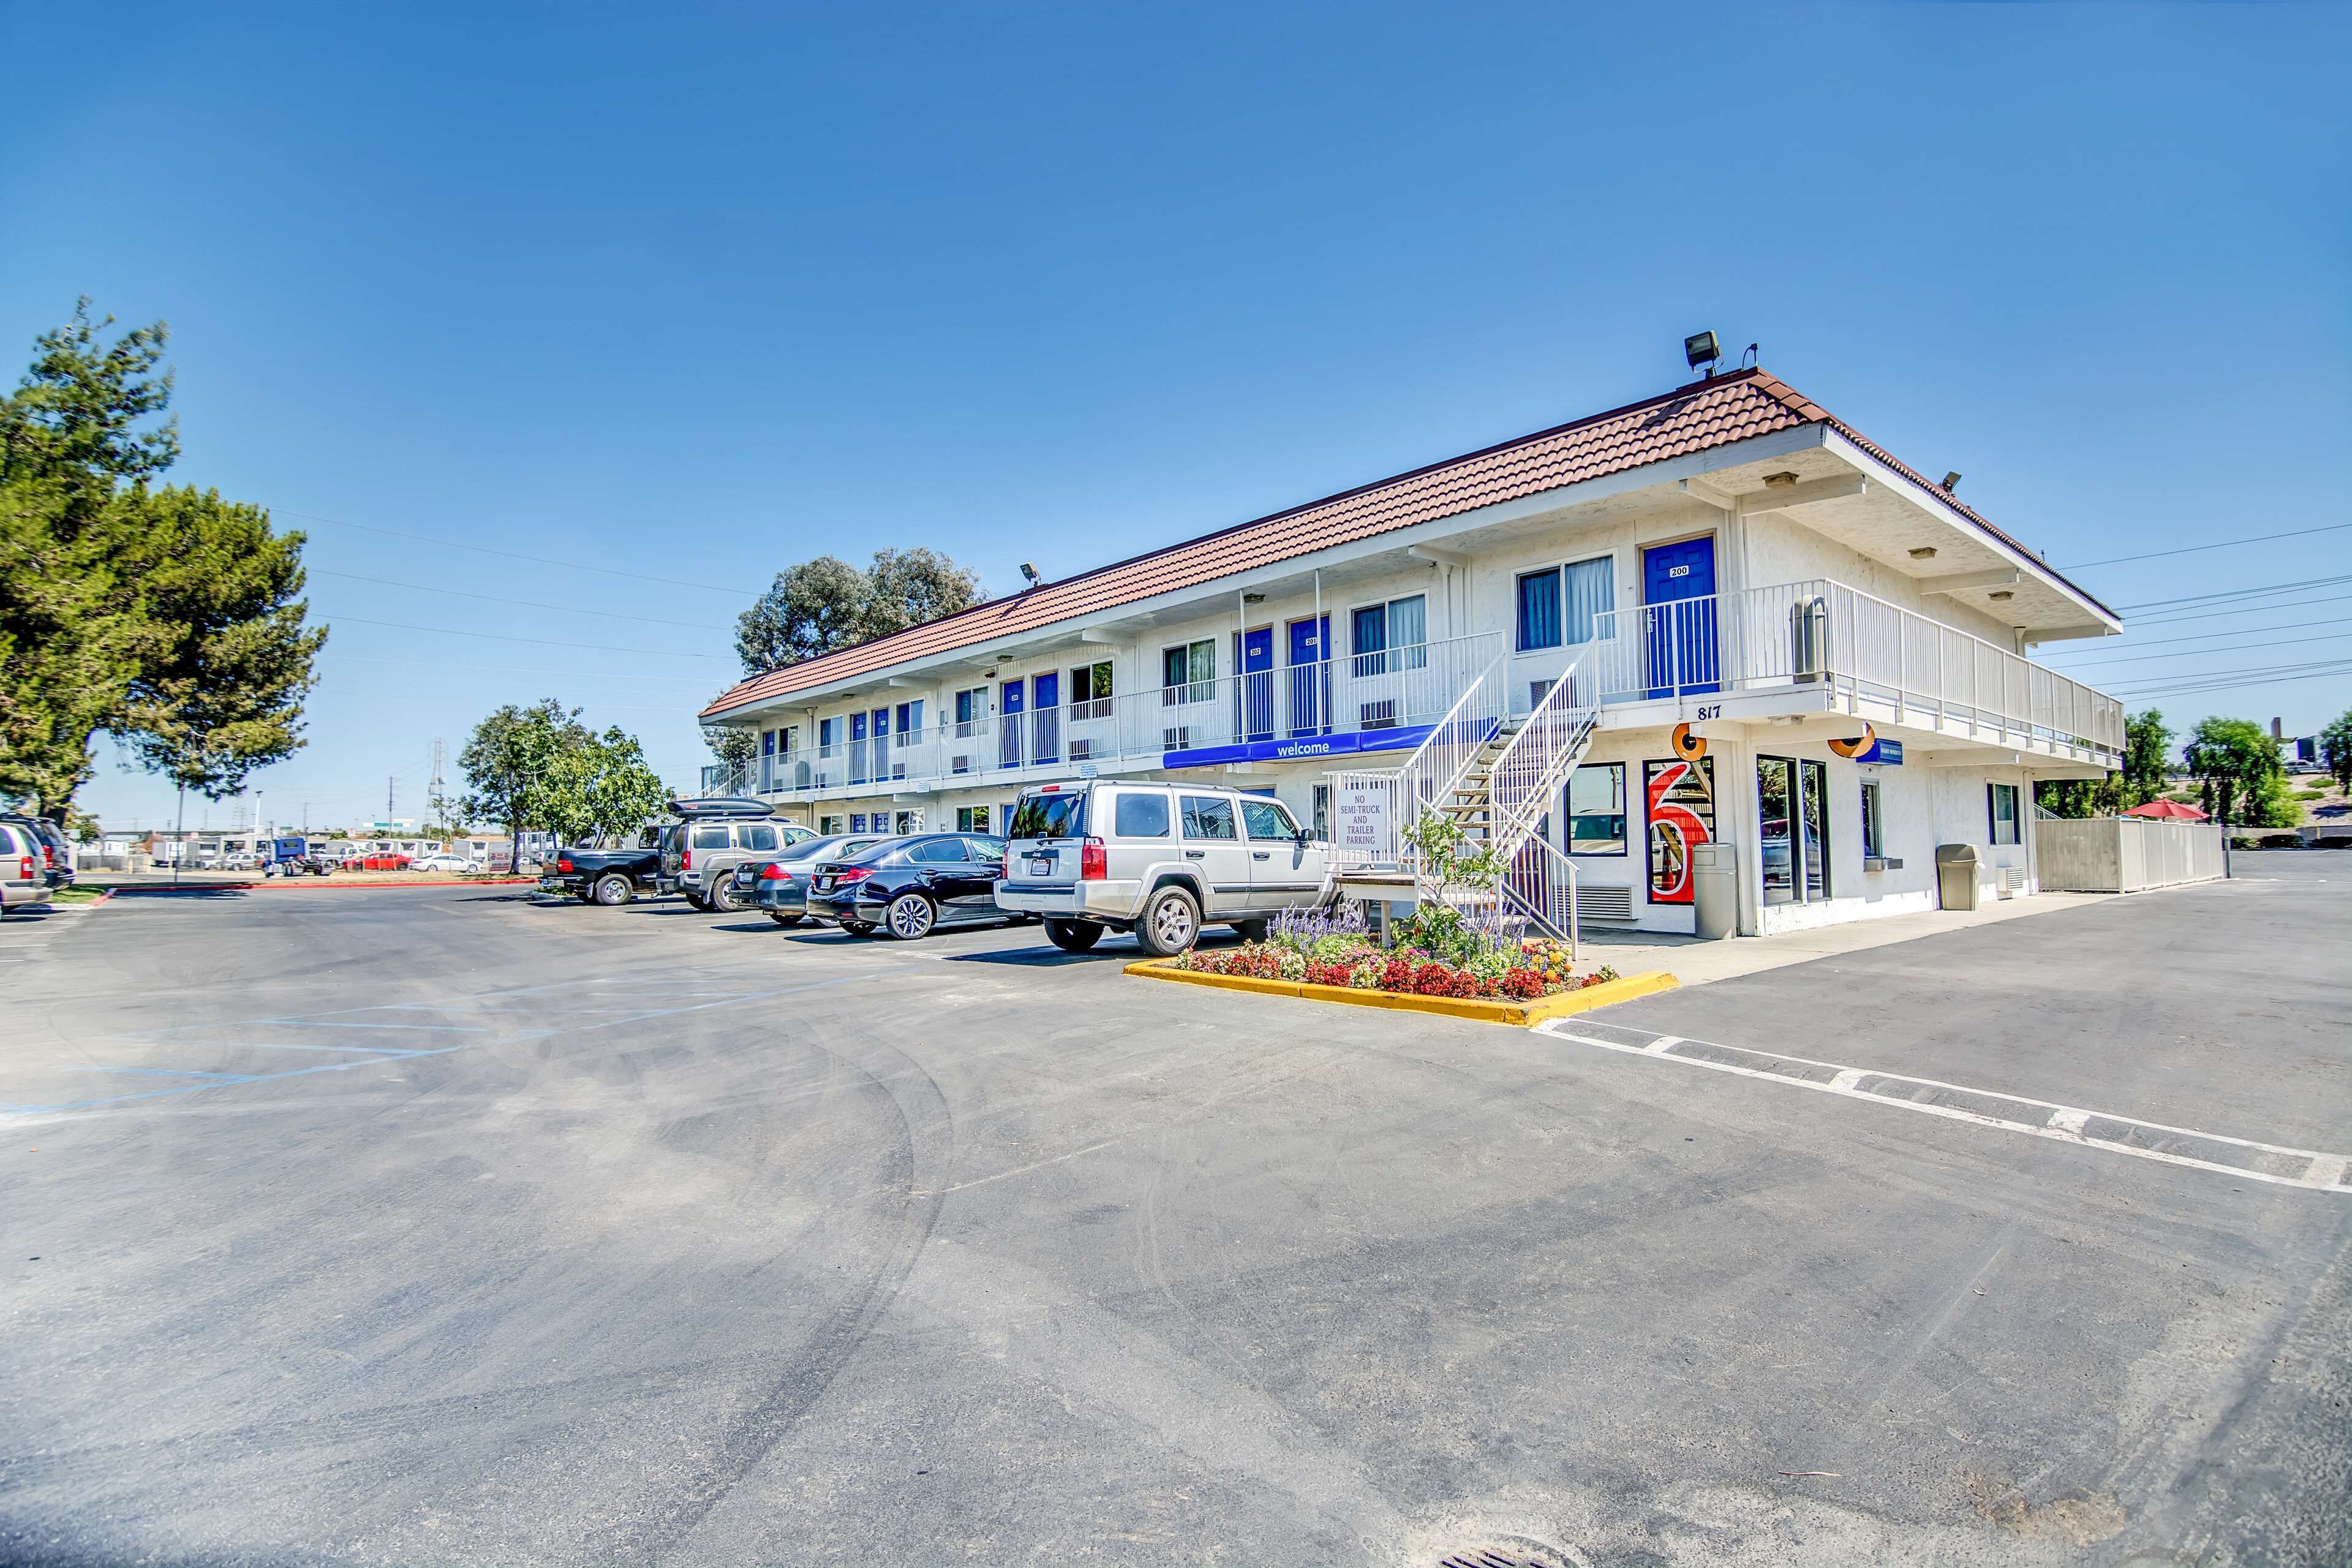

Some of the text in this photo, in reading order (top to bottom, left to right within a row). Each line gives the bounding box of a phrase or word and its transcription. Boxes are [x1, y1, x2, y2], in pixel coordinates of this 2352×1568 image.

[1672, 567, 1687, 576] 200
[1698, 704, 1721, 720] 817
[1277, 741, 1330, 756] welcome
[1355, 795, 1365, 804] NO
[1341, 805, 1381, 814] SEMI-TRUCK
[1353, 815, 1367, 824] AND
[1348, 826, 1374, 834] TRAILER
[1346, 835, 1375, 845] PARKING
